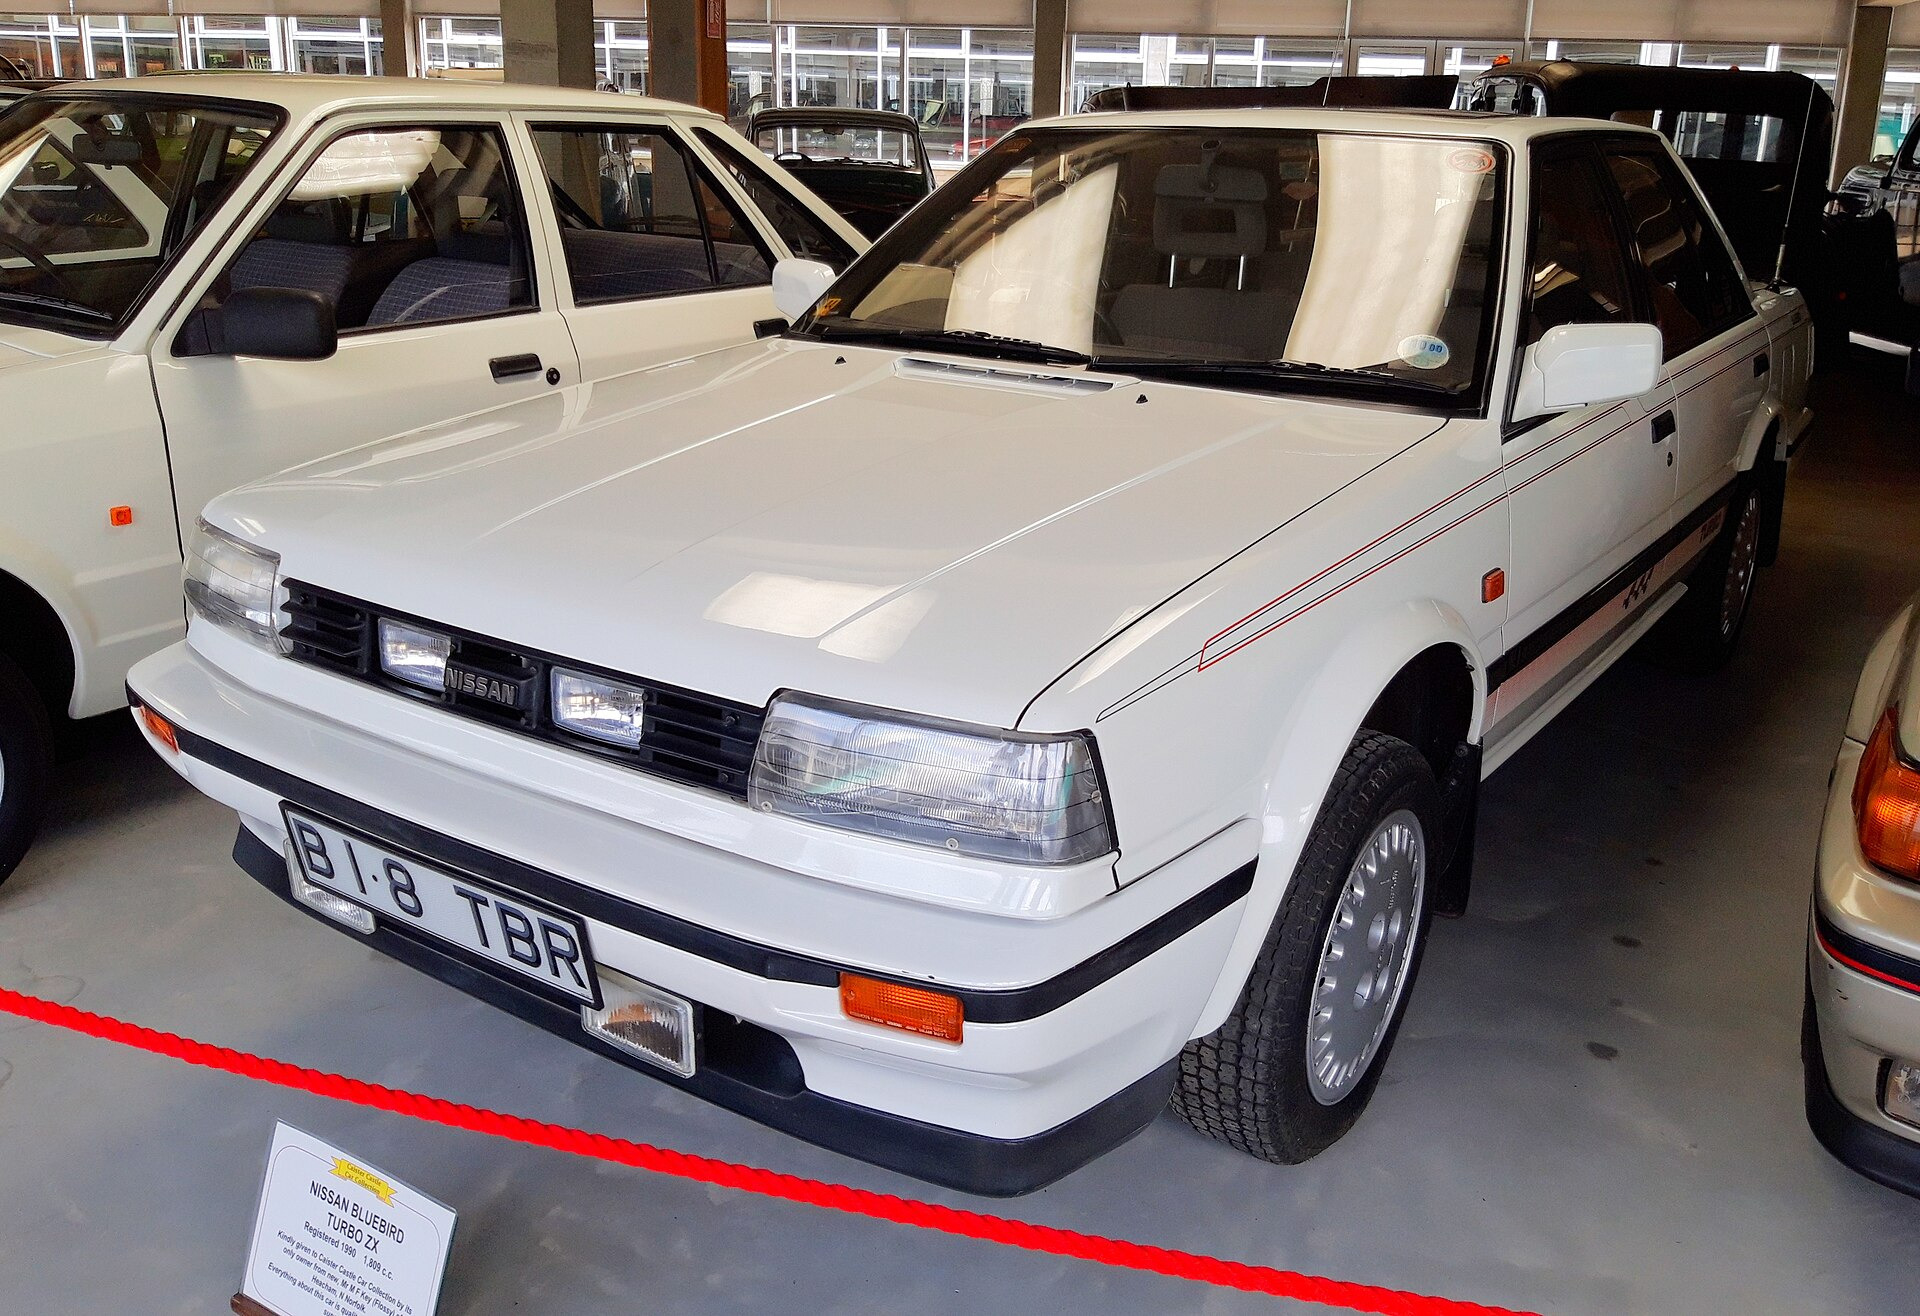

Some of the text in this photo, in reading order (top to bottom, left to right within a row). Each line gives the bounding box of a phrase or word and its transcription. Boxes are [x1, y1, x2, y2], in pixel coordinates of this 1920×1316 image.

[445, 667, 515, 705] NISSAN
[452, 884, 587, 989] TBR
[345, 1171, 380, 1194] Car Collection
[347, 1163, 364, 1176] Caister
[310, 1180, 404, 1244] NISSAN BLUEBIRD
[328, 1212, 379, 1254] TURBO ZX
[277, 1230, 295, 1246] Kindly
[296, 1242, 311, 1254] given
[312, 1250, 318, 1258] to
[319, 1253, 338, 1269] Caister
[339, 1265, 356, 1281] Castle
[357, 1276, 367, 1287] Car
[368, 1282, 396, 1304] Collection
[397, 1300, 404, 1311] by
[304, 1221, 393, 1280] Registered 1990 1,809 c.c.
[268, 1262, 297, 1286] Everything
[297, 1280, 314, 1294] about
[314, 1288, 324, 1300] this
[325, 1297, 334, 1306] car
[335, 1302, 340, 1310] is
[283, 1247, 295, 1259] only
[296, 1254, 313, 1267] owner
[313, 1263, 326, 1276] from
[326, 1272, 339, 1285] new,
[341, 1279, 348, 1289] Mr
[349, 1284, 355, 1293] M
[360, 1290, 372, 1304] Key
[312, 1275, 338, 1298] Heacham,
[345, 1294, 366, 1313] Norfolk.
